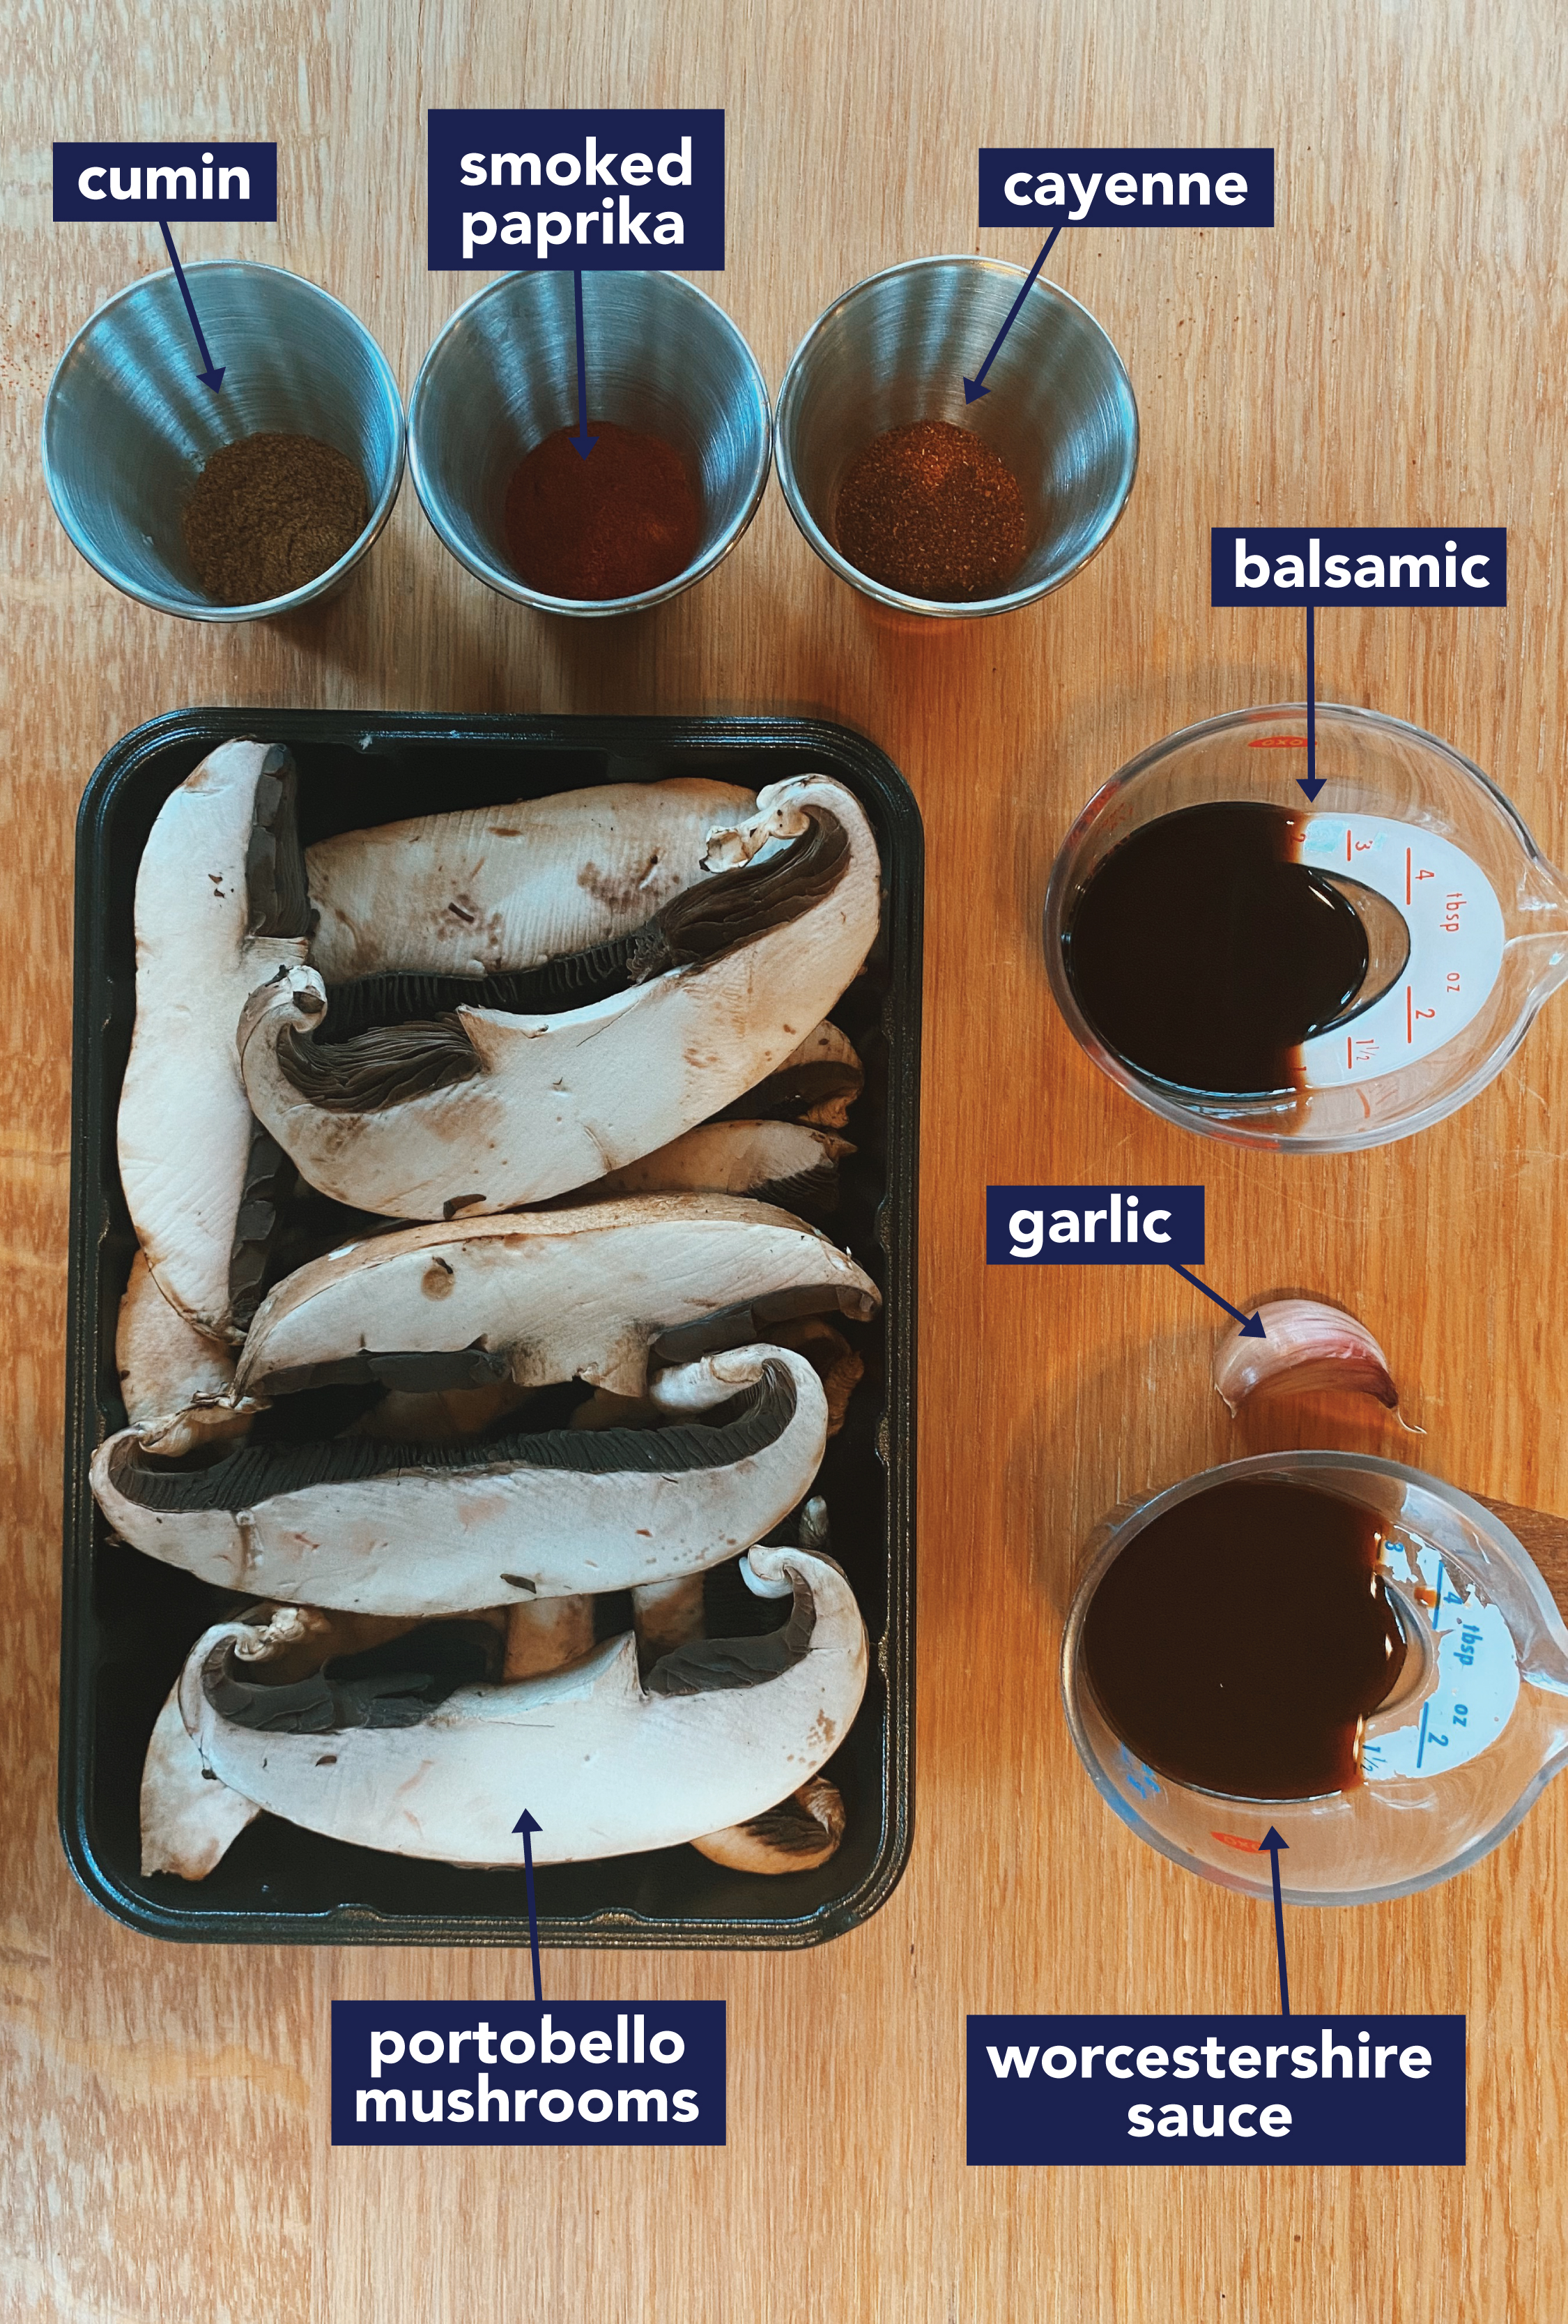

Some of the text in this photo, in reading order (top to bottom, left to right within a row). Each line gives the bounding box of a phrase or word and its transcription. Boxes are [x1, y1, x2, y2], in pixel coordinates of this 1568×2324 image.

[1355, 840, 1374, 851] 3
[1415, 869, 1435, 880] 4
[1439, 892, 1467, 932] tbsp
[1446, 972, 1461, 993] oz
[1415, 1008, 1436, 1020] 2
[1443, 1591, 1464, 1605] 4
[1453, 1623, 1484, 1666] tbsp
[1452, 1704, 1468, 1727] oz
[1428, 1731, 1449, 1747] 2
